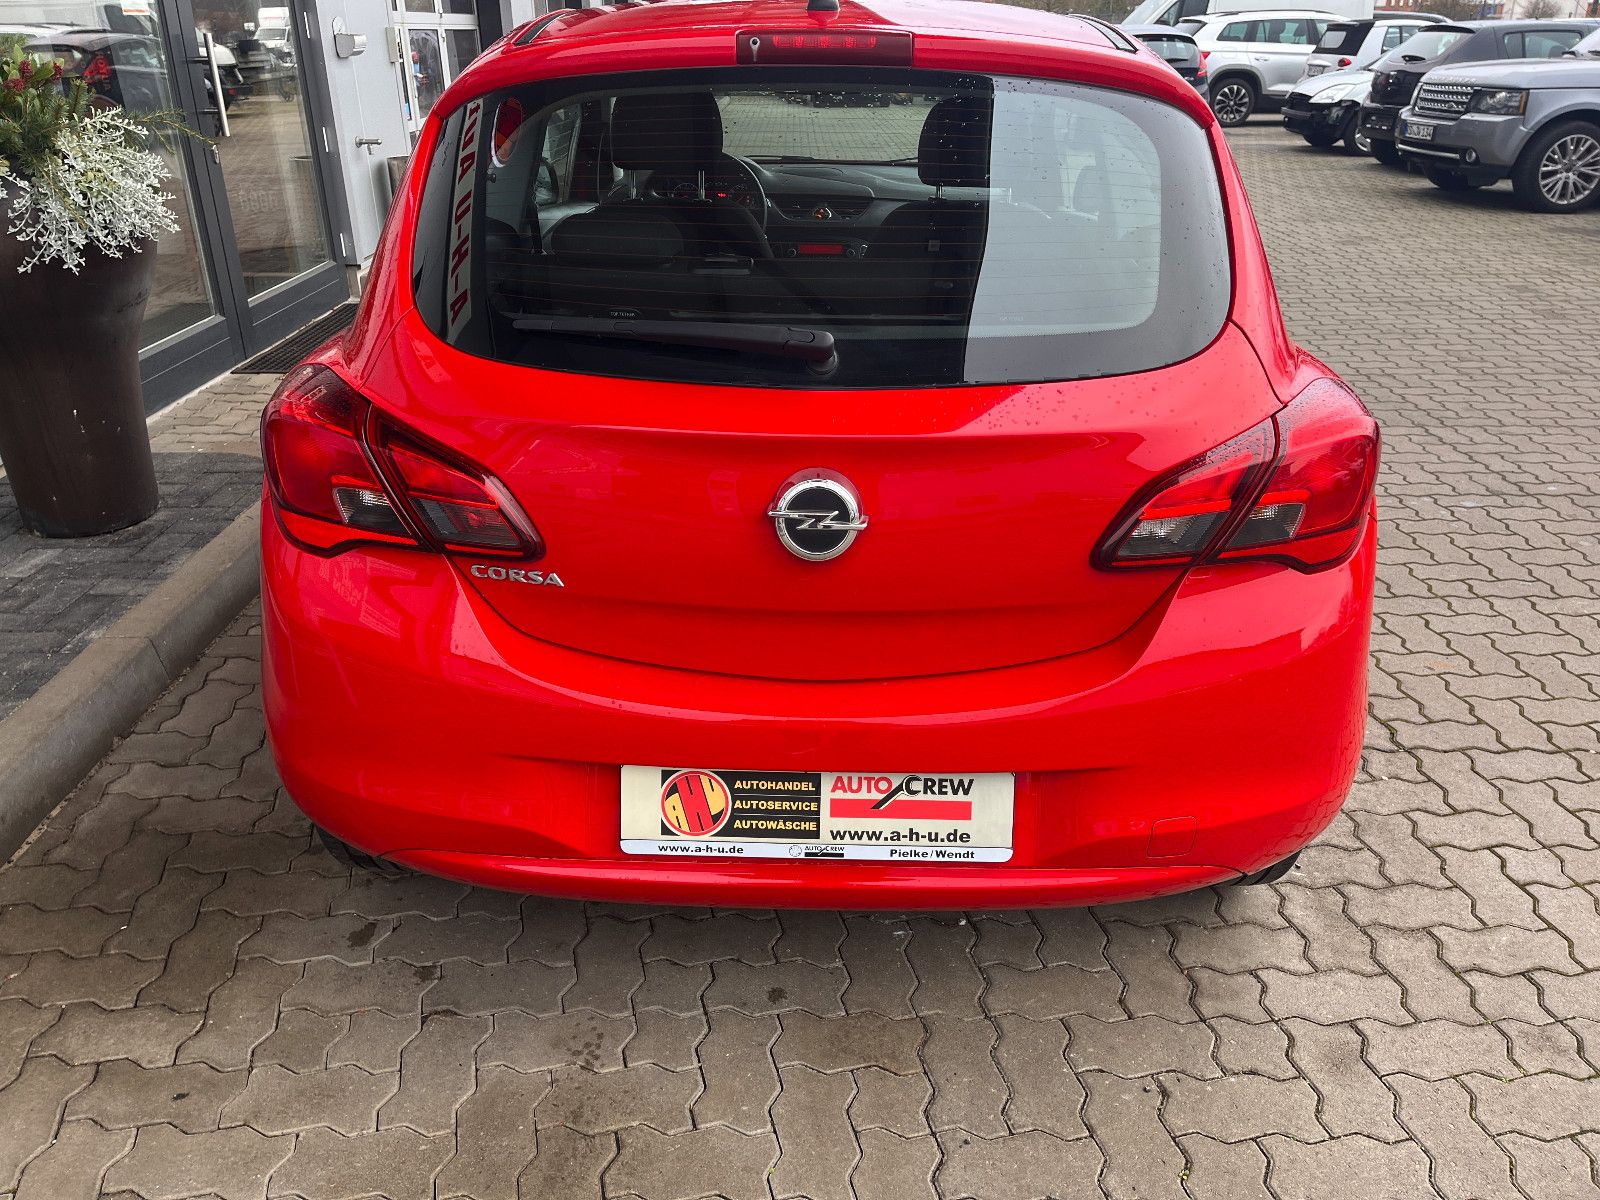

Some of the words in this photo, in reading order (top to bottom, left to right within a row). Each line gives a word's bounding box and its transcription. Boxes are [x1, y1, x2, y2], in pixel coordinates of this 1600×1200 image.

[470, 564, 565, 588] CORSA
[734, 779, 816, 791] AUTOHANDEL
[830, 775, 893, 795] AUTO
[903, 774, 975, 797] CREW
[733, 799, 818, 811] AUTOSERVICE
[733, 819, 817, 831] AUTOWÄSCHE
[829, 828, 971, 844] www.a-h-u.de
[657, 844, 744, 855] www.a-h-u.de
